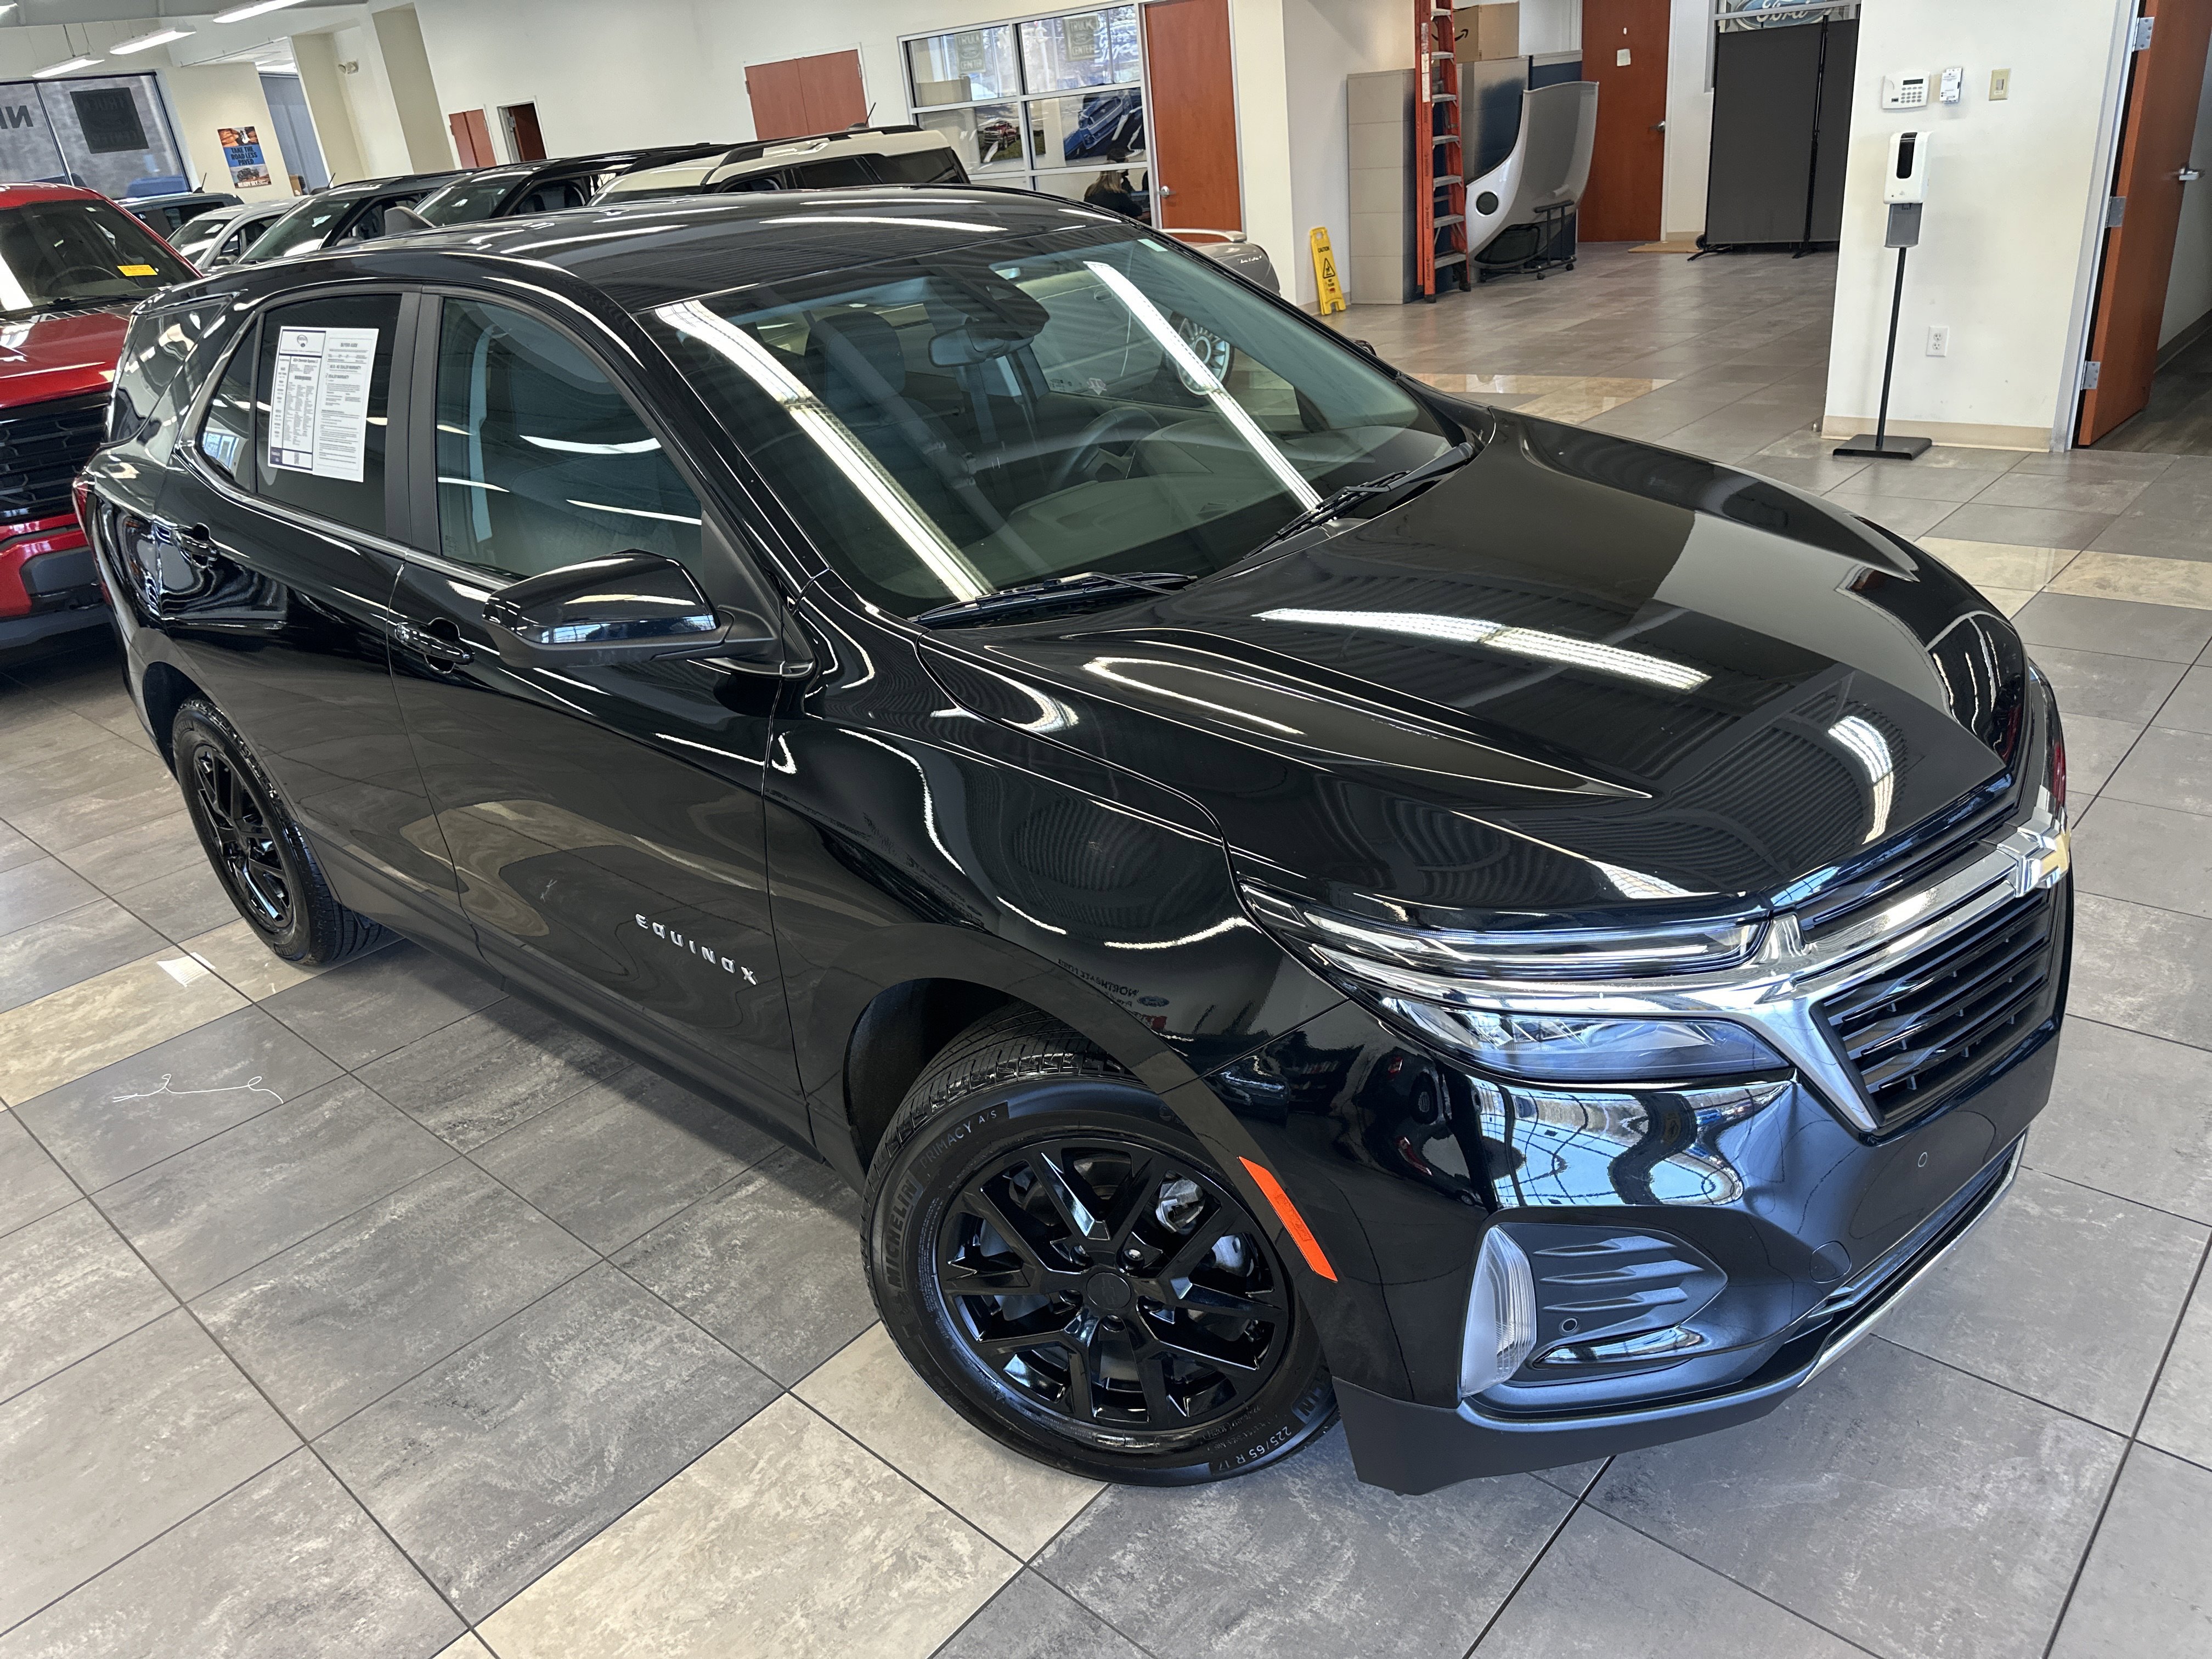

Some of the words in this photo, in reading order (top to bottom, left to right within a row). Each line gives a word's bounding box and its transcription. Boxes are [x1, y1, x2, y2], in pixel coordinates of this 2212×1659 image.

[635, 913, 758, 986] EQUINOX
[919, 1120, 972, 1169] PRIMACY
[978, 1110, 997, 1124] A/S
[884, 1178, 918, 1289] MICHELIN
[1235, 1454, 1246, 1464] R
[1249, 1426, 1292, 1459] 225/65
